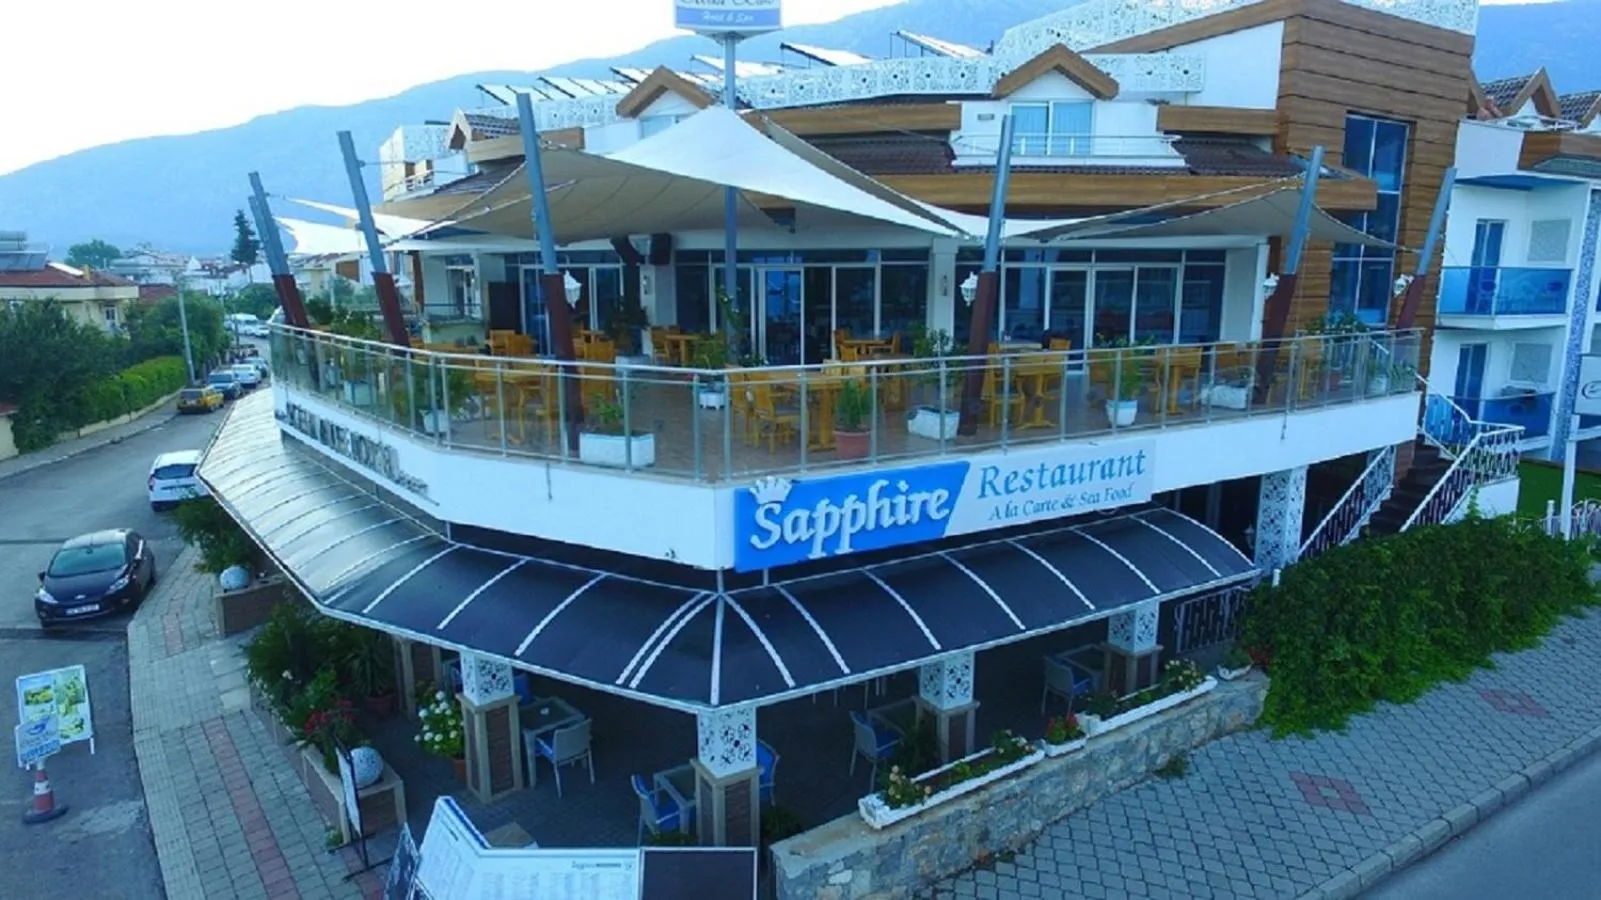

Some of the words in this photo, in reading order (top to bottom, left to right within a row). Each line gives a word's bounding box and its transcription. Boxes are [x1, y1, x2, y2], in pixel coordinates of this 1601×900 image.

[977, 449, 1147, 499] Restaurant
[750, 479, 949, 559] Sapphire
[989, 505, 1002, 521] A
[1004, 499, 1019, 518] la
[1023, 497, 1058, 516] Carte
[1061, 494, 1077, 510] &
[1079, 491, 1101, 506] Sea
[1104, 481, 1136, 502] Food
